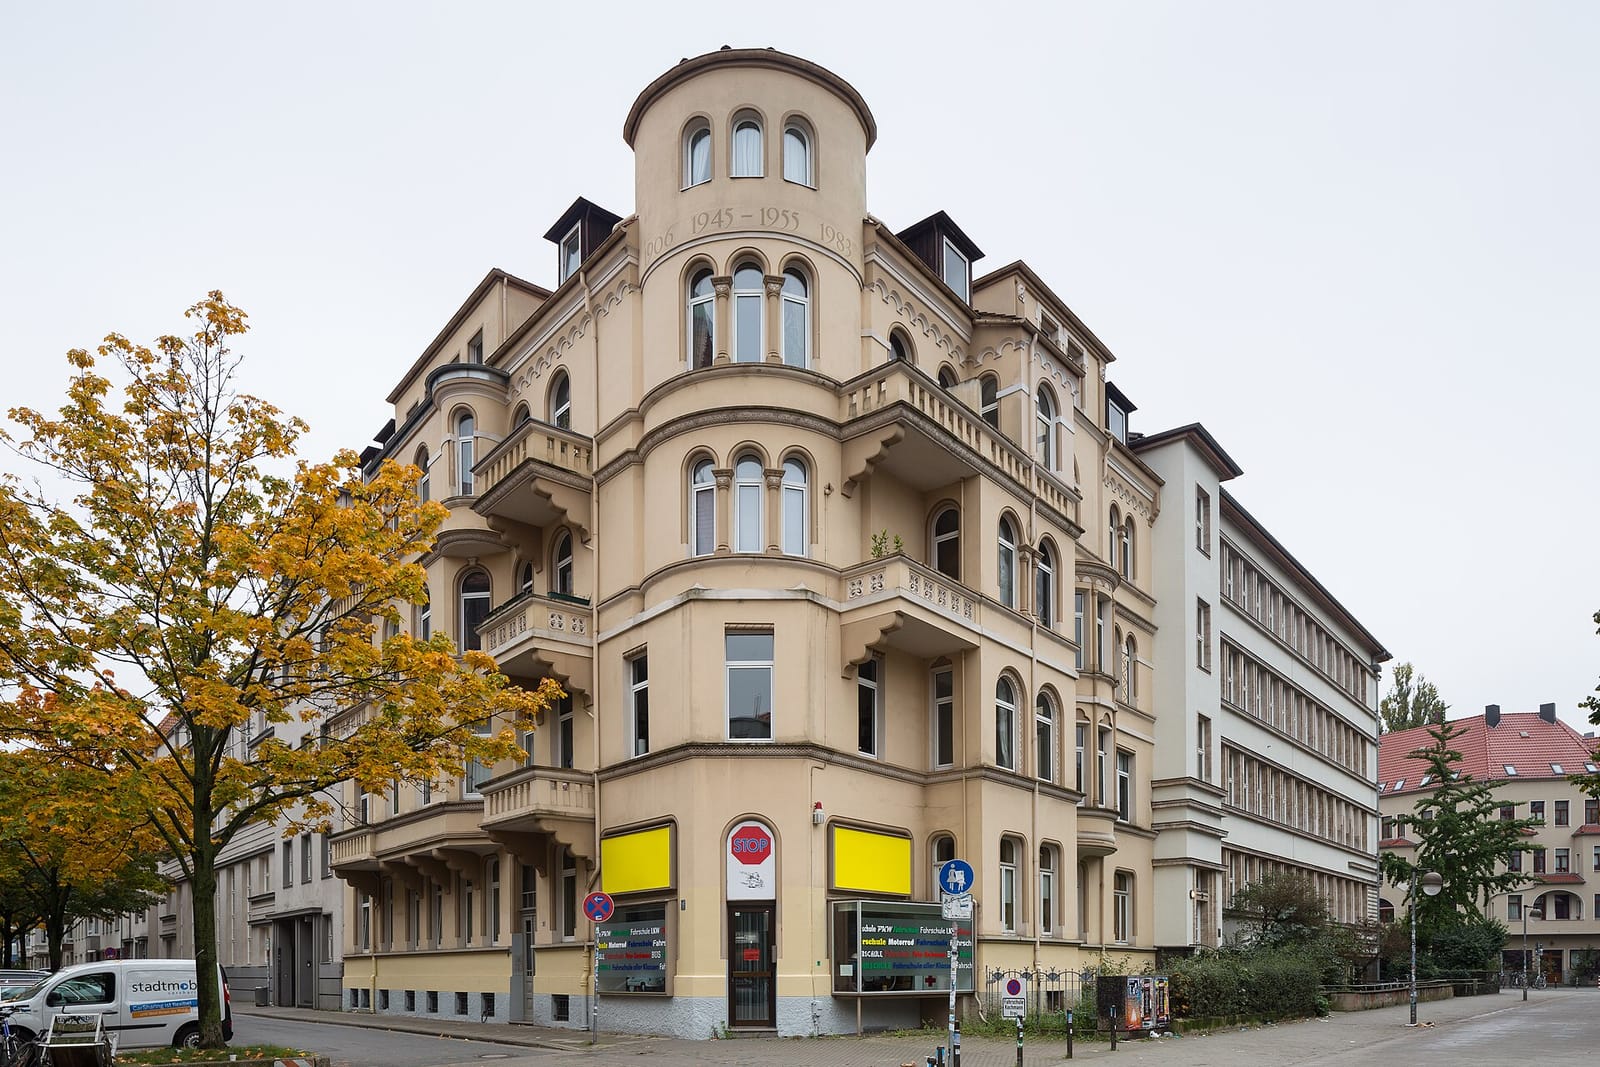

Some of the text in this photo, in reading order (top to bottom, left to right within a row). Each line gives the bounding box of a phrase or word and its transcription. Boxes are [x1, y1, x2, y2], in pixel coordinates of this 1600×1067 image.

[691, 207, 734, 234] 1945
[759, 207, 800, 231] 1955
[820, 223, 852, 257] 1983
[733, 838, 768, 853] STOP
[920, 926, 946, 935] Fahrschule
[888, 938, 915, 946] Motorrad
